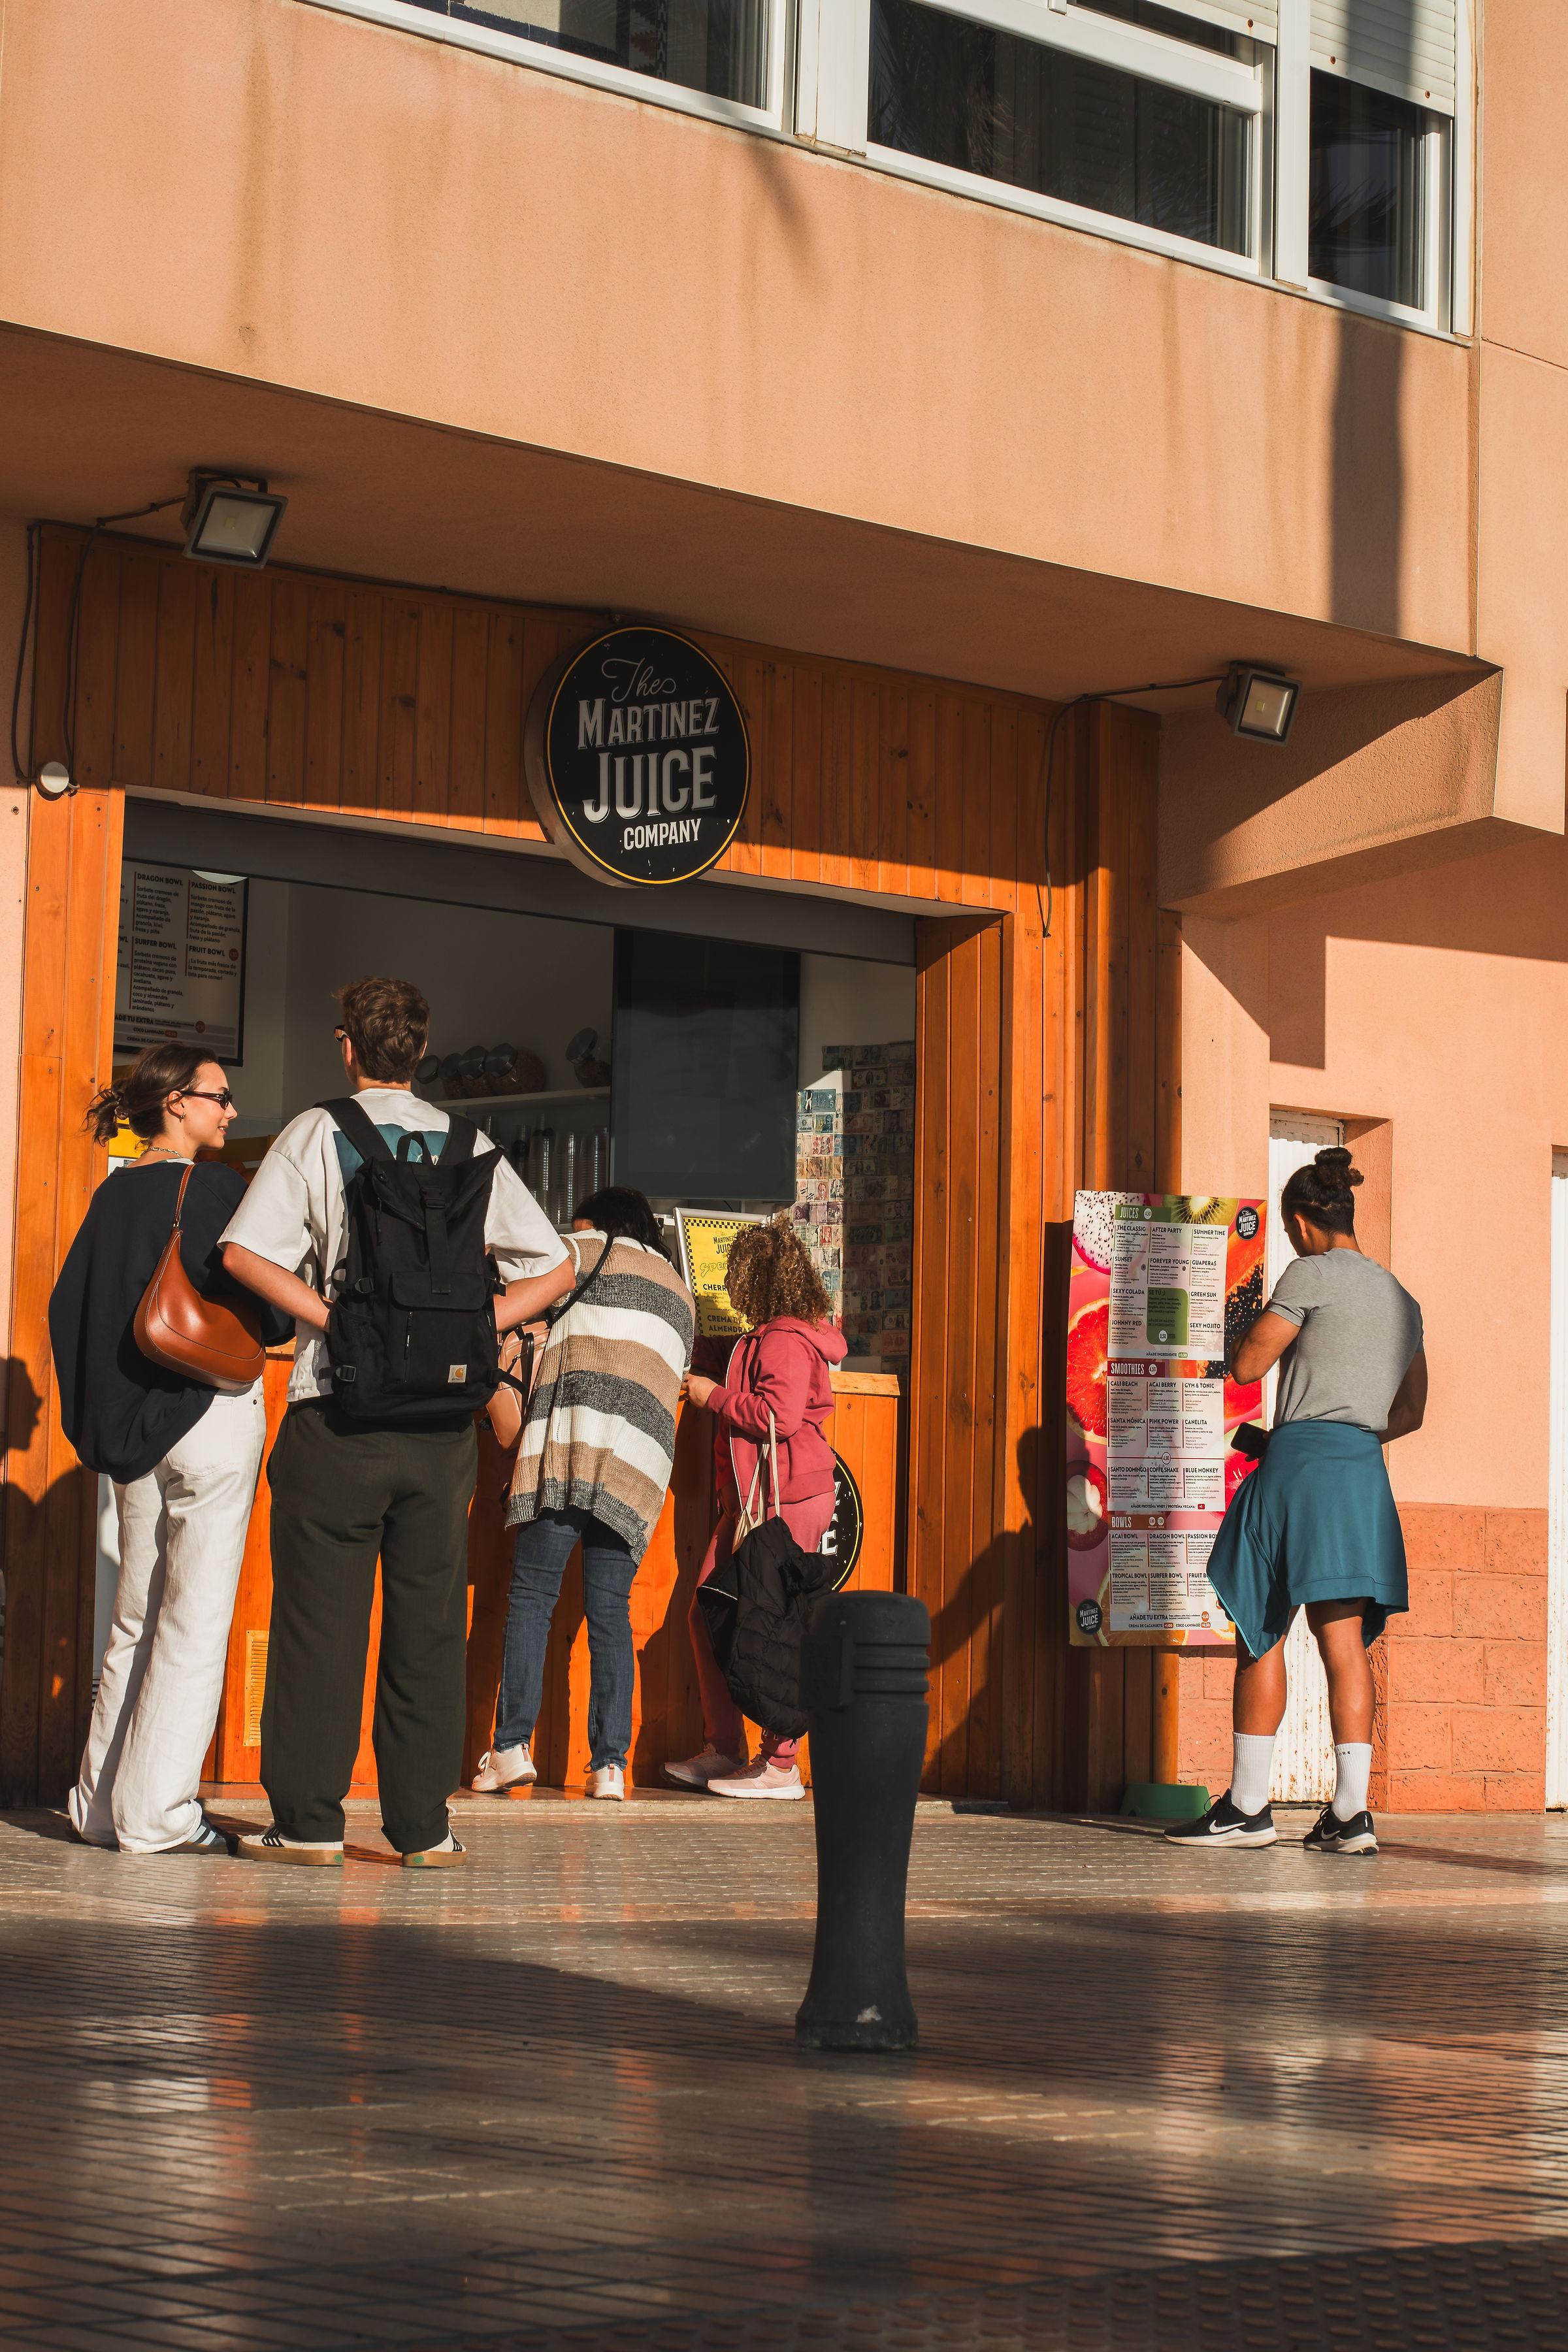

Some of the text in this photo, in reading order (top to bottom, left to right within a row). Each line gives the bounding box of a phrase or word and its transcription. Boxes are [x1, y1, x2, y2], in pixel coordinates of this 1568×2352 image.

[601, 657, 676, 702] The
[578, 697, 719, 750] MARTINEZ
[582, 745, 717, 823] JUICE
[623, 818, 702, 851] COMPANY
[137, 874, 163, 883] DRAGON
[191, 881, 217, 890] PASSION
[135, 938, 176, 949] SURFER BOWL
[208, 948, 225, 956] BOWL
[1120, 1207, 1139, 1218] JUICES
[1239, 1215, 1256, 1224] MARTINEZ
[1239, 1221, 1256, 1233] JUICE
[1111, 1363, 1144, 1375] SMOOTHIES
[1111, 1516, 1132, 1527] BOWLS
[1081, 1614, 1098, 1627] JUICE
